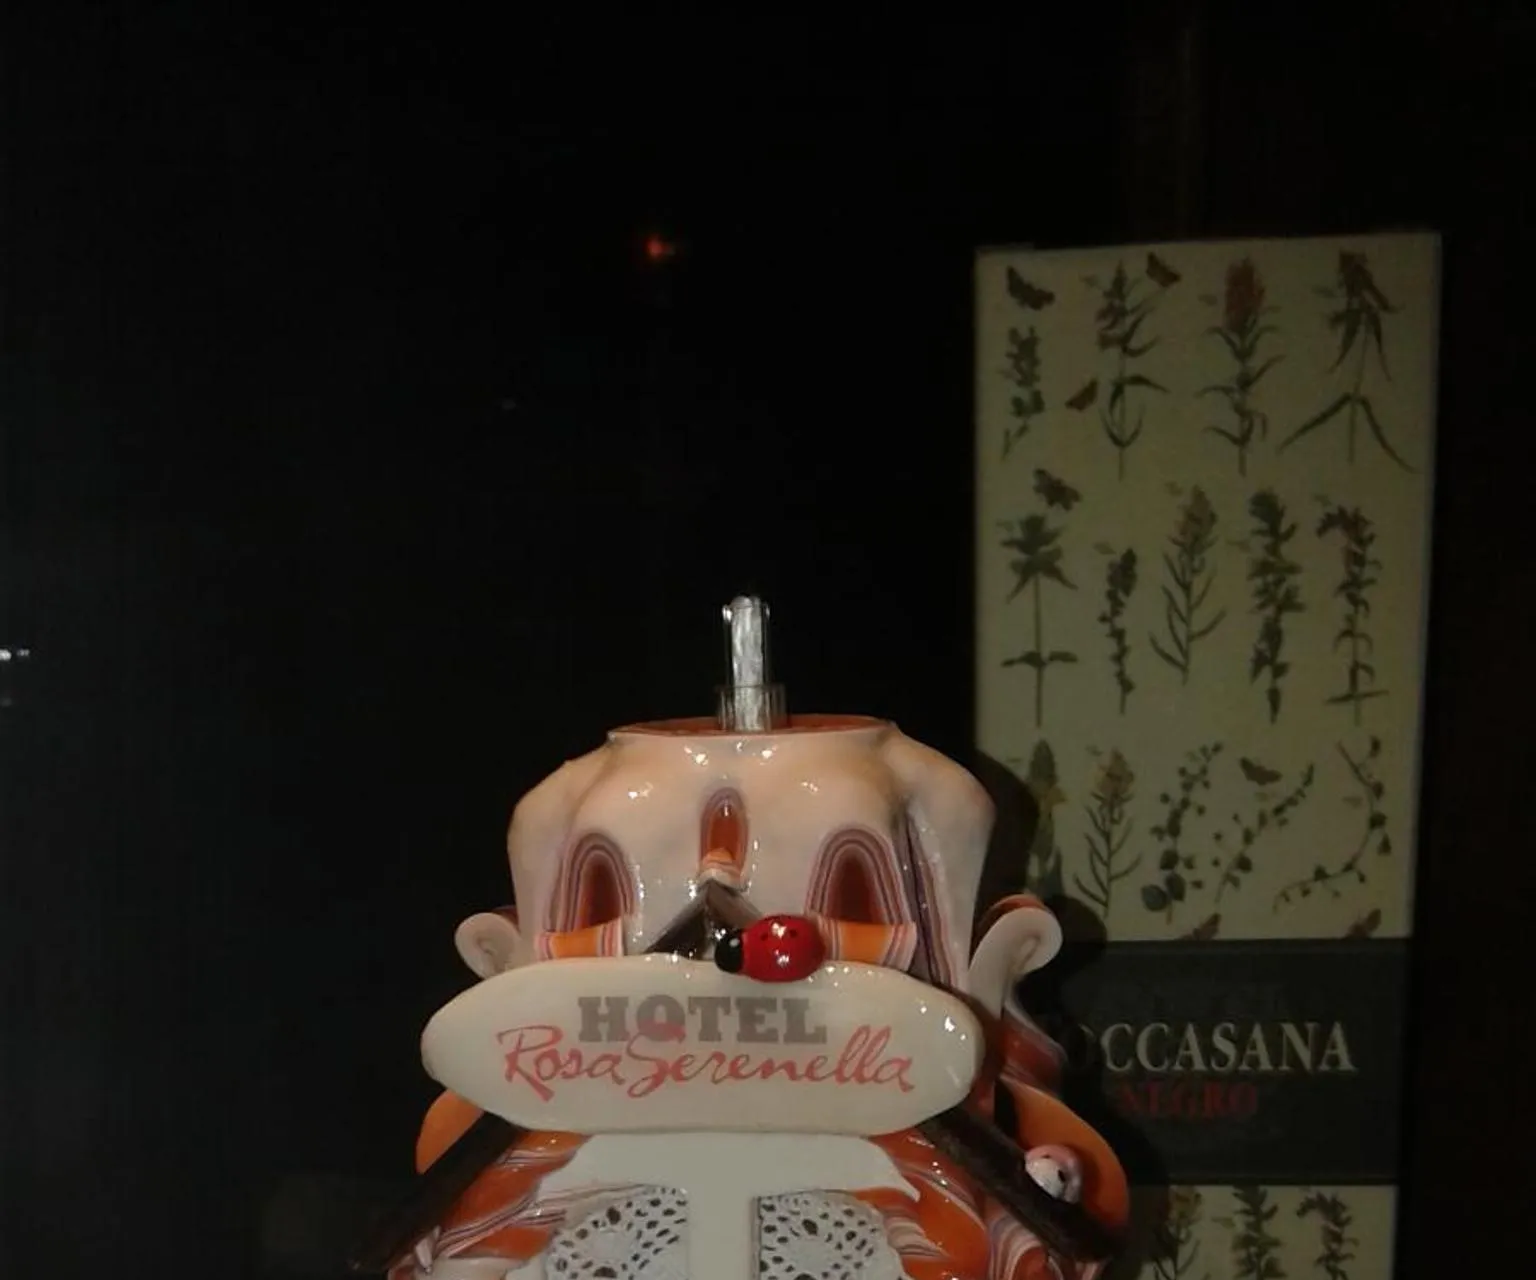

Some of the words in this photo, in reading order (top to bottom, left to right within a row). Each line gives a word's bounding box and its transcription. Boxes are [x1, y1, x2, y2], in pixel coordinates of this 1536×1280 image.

[578, 995, 828, 1043] HOTEL
[496, 1025, 623, 1100] Rosa
[625, 1021, 915, 1098] Serenella
[1074, 1022, 1357, 1073] CCASANA
